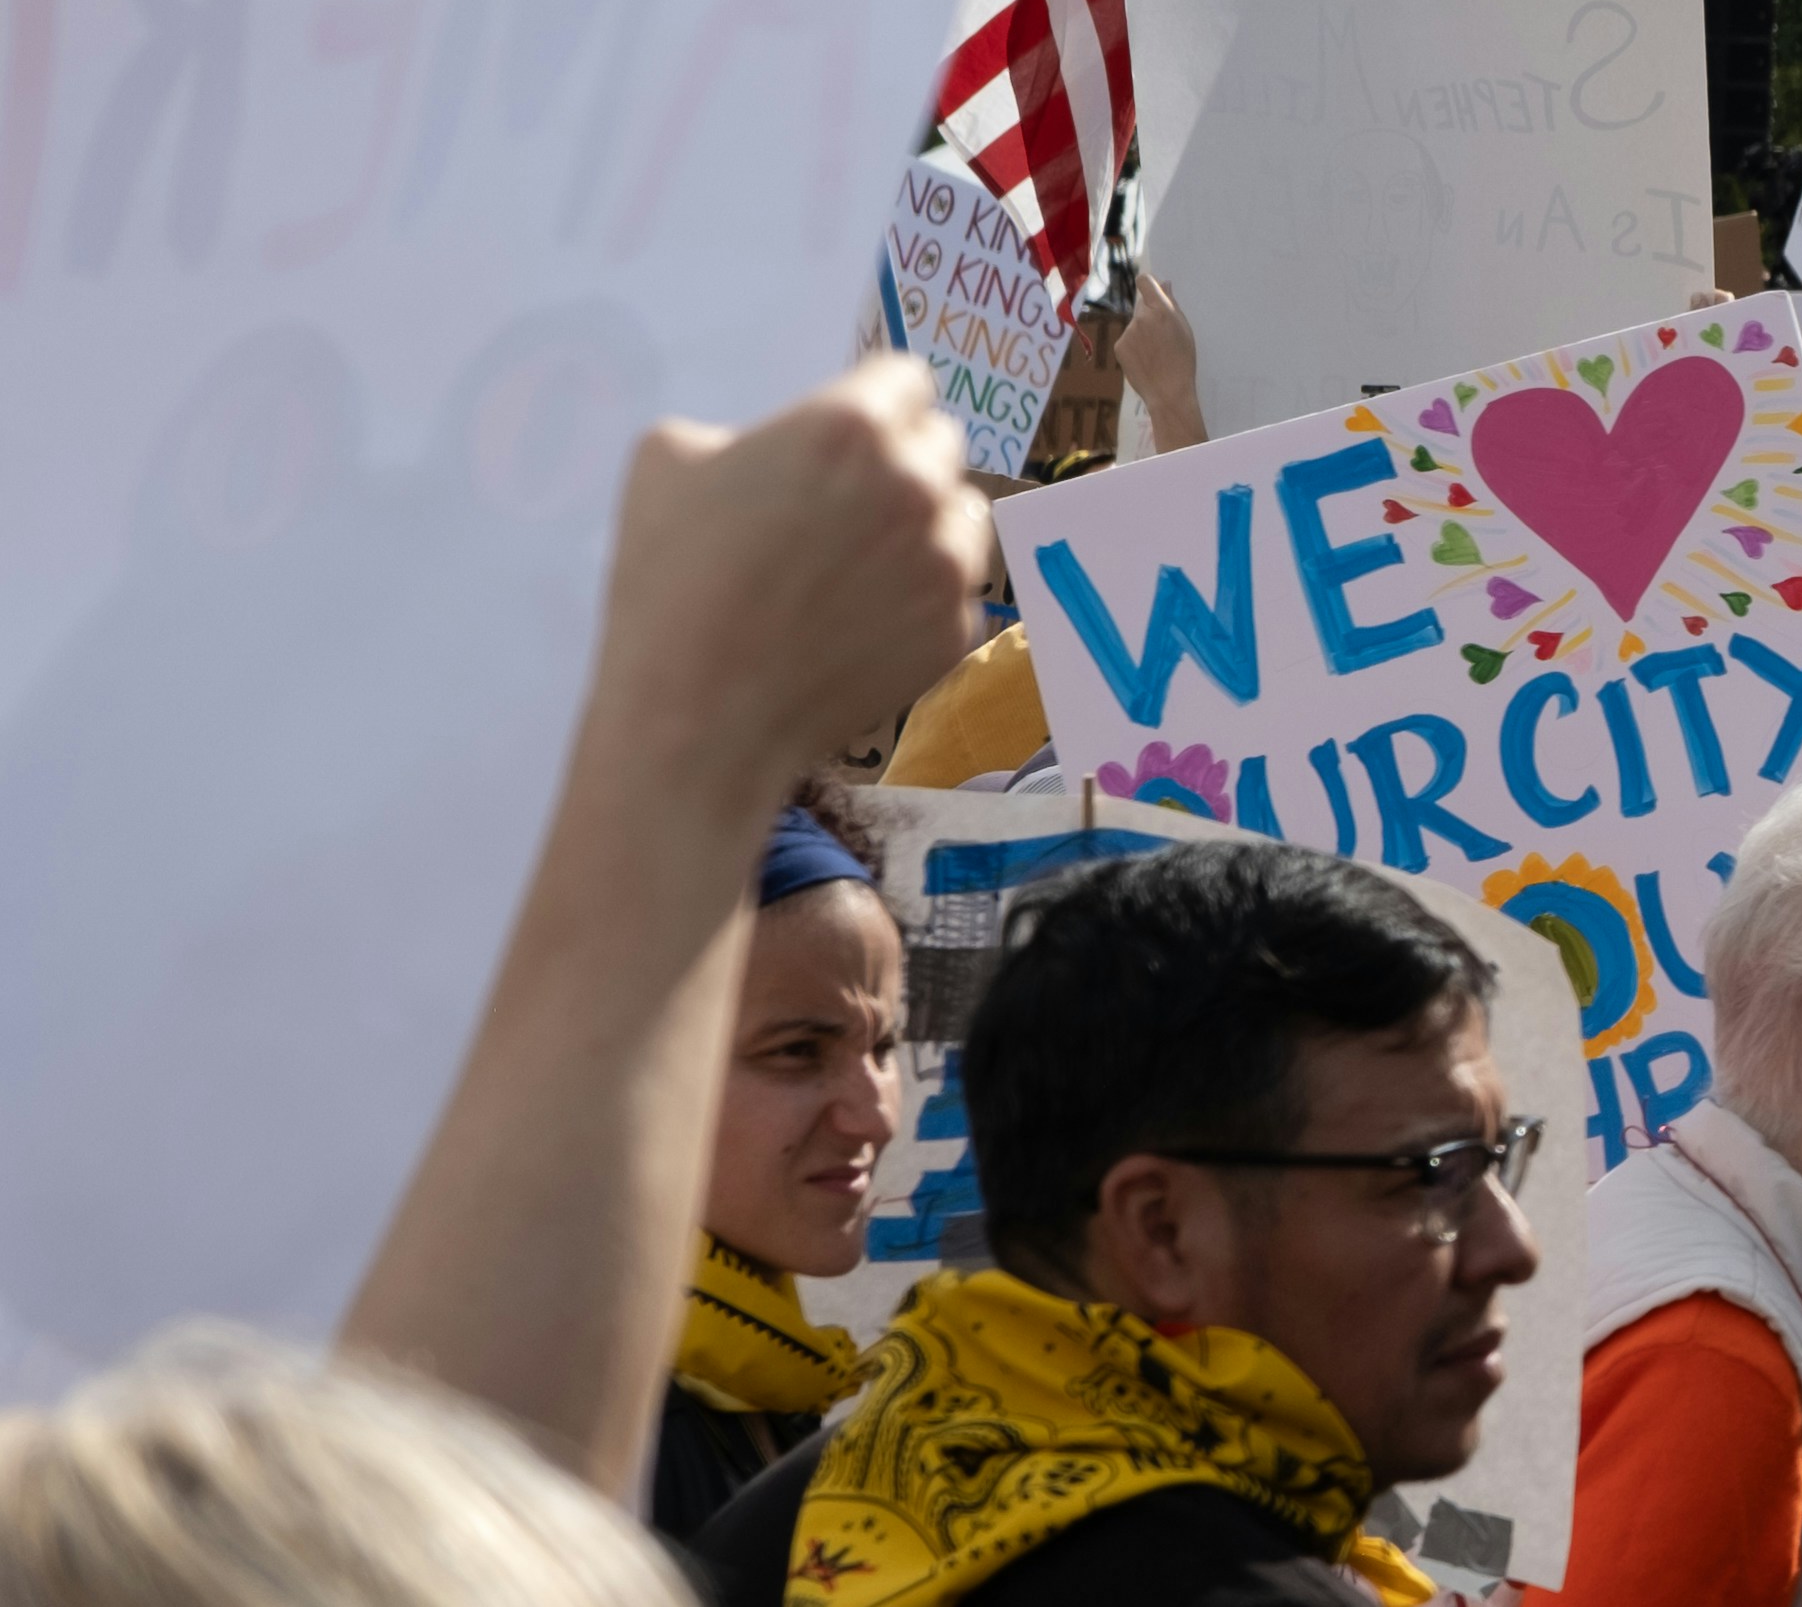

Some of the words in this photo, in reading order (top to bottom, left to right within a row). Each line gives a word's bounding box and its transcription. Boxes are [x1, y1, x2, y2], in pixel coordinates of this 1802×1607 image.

[965, 196, 1036, 264] KIN
[947, 253, 1067, 340] KINGS
[933, 302, 1056, 390] KINGS
[1036, 437, 1445, 729] WE
